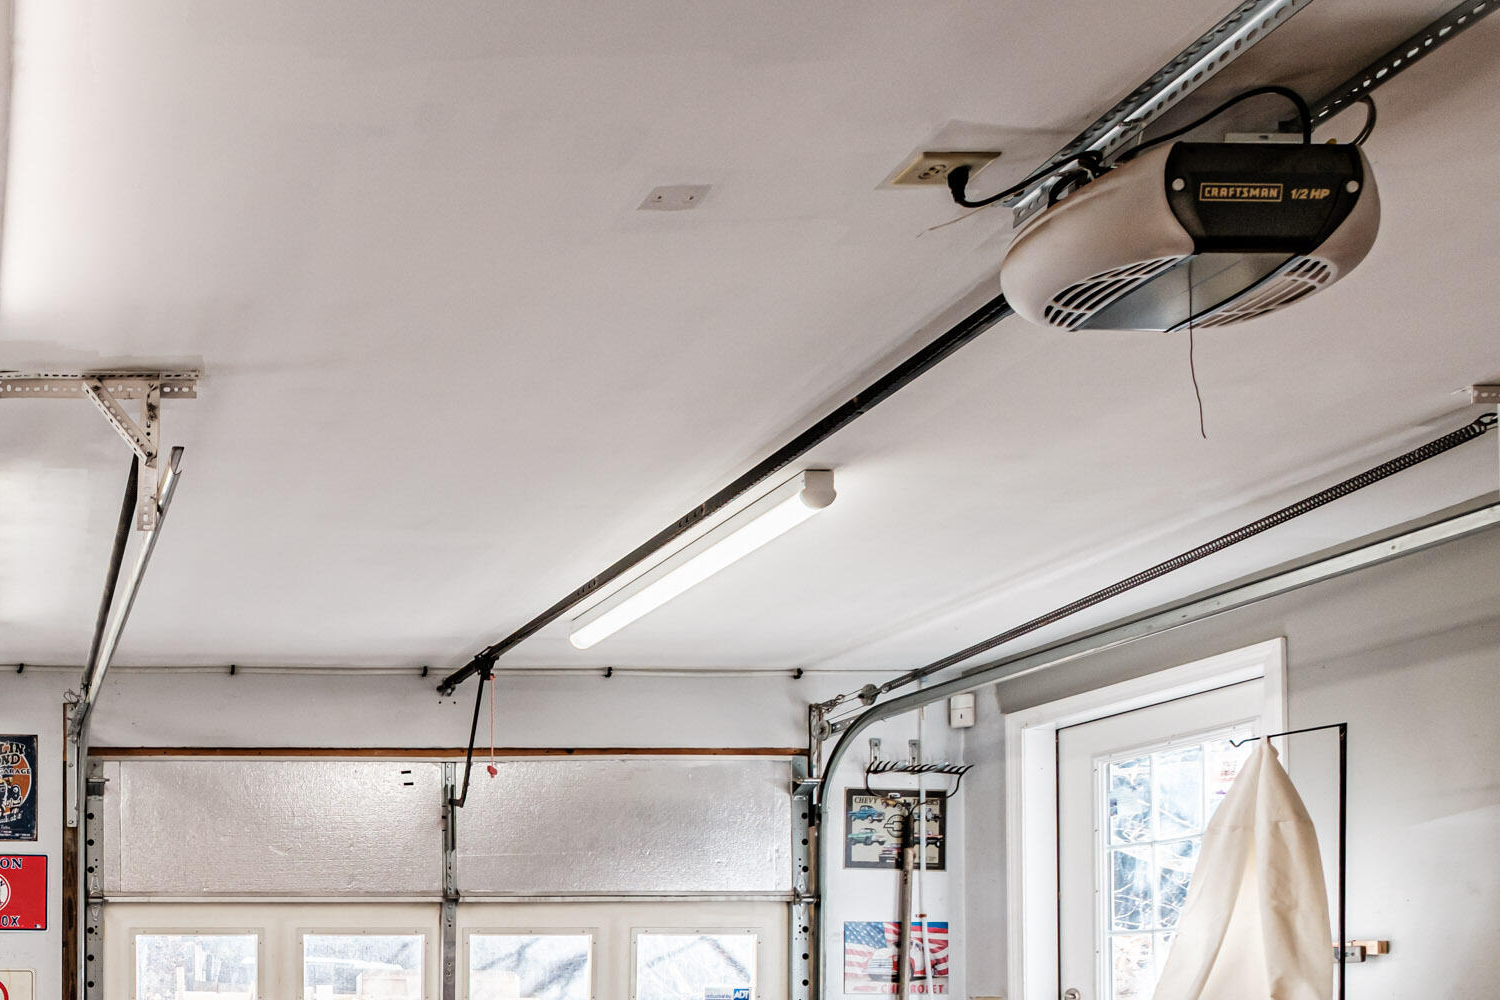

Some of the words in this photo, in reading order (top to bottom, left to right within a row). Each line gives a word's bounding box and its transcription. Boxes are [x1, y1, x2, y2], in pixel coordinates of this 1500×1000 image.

[1204, 187, 1278, 198] CRAFTSMAN
[1291, 188, 1309, 199] 1/2
[1310, 188, 1331, 199] HP
[734, 989, 749, 1000] ADT
